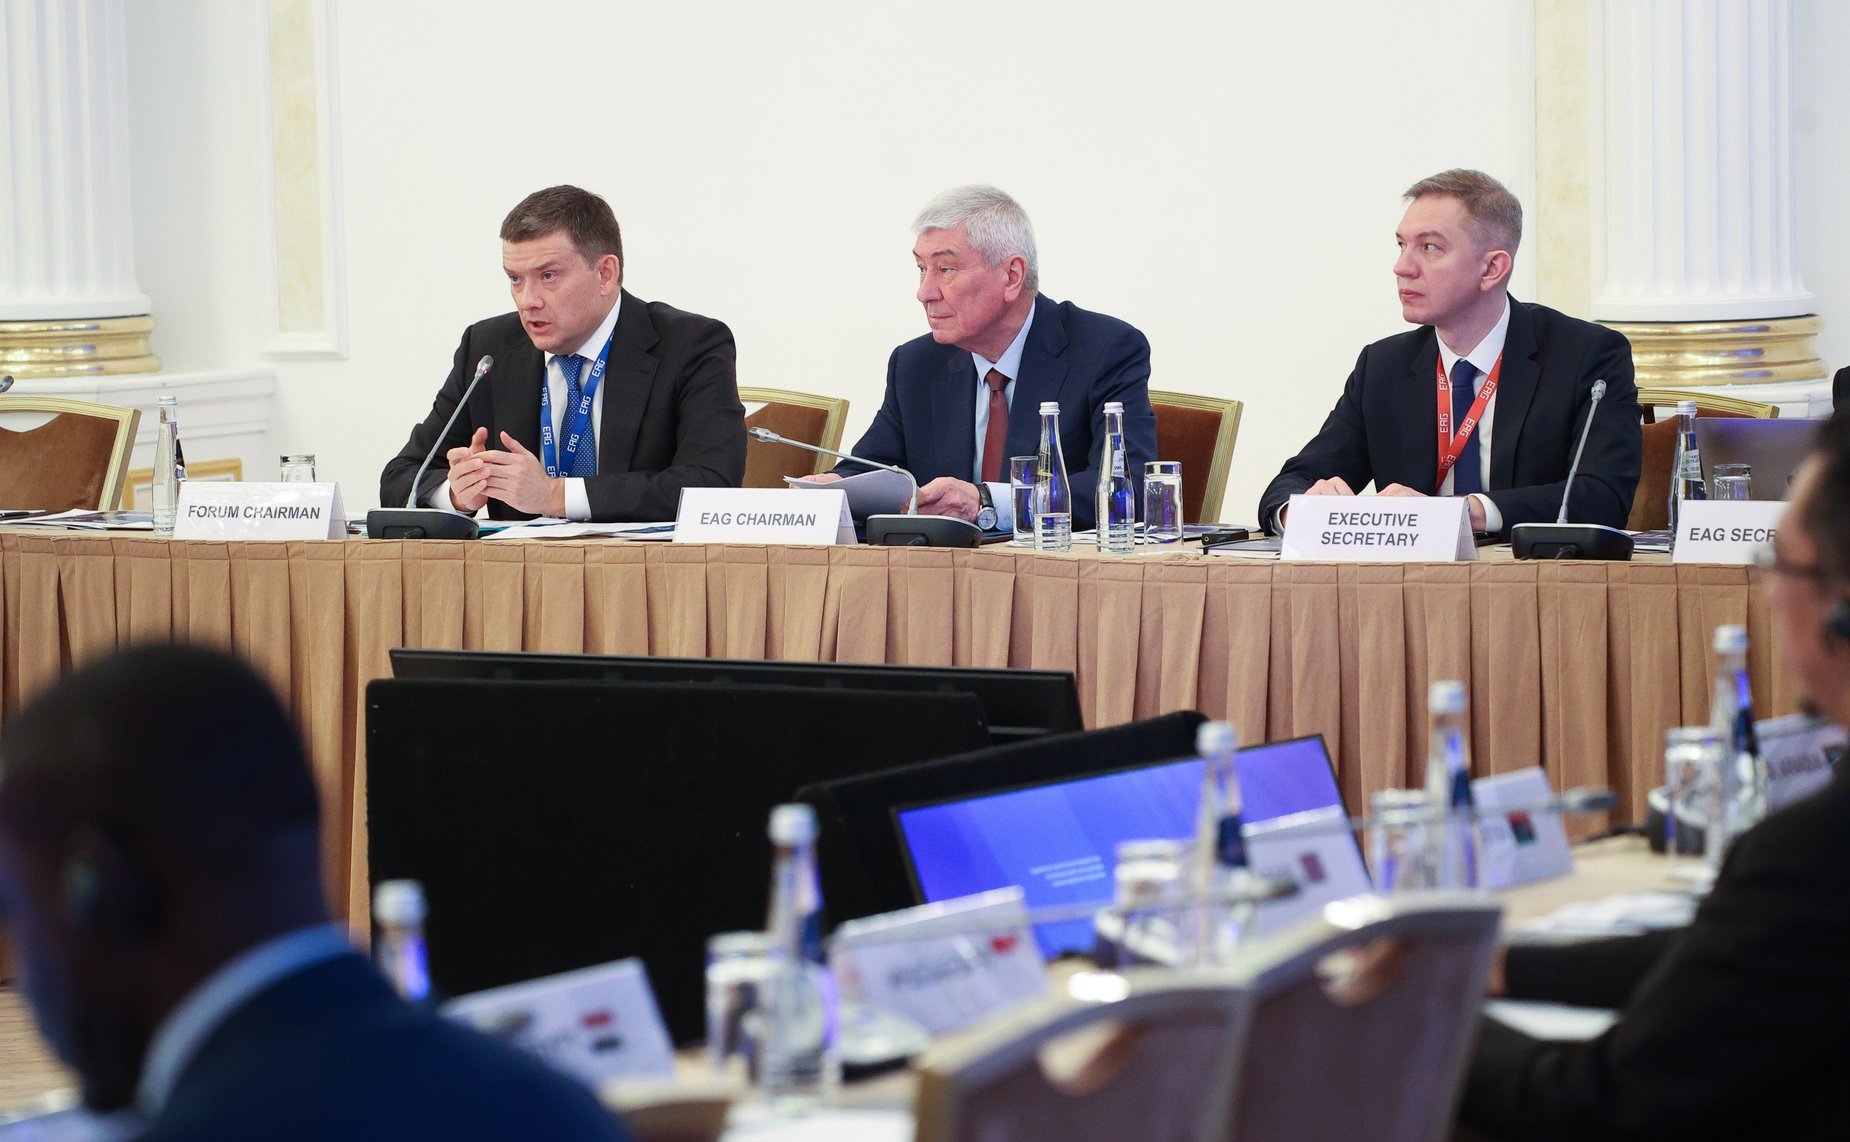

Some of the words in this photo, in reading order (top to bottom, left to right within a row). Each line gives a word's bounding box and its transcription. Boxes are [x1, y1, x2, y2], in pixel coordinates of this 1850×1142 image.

[591, 359, 606, 378] EAG
[1438, 372, 1449, 391] EAG
[1480, 380, 1496, 400] EAG
[541, 387, 549, 407] EAG
[579, 395, 592, 415] EAG
[1440, 413, 1449, 433] EAG
[1459, 417, 1476, 438] EAG
[542, 426, 553, 446] EAG
[567, 433, 580, 453] EAG
[546, 465, 556, 478] EA
[188, 505, 240, 519] FORUM
[243, 506, 321, 519] CHAIRMAN
[700, 512, 732, 525] EAG
[736, 513, 817, 526] CHAIRMAN
[1328, 512, 1419, 527] EXECUTIVE
[1320, 531, 1420, 547] SECRETARY
[1689, 527, 1726, 542] EAG
